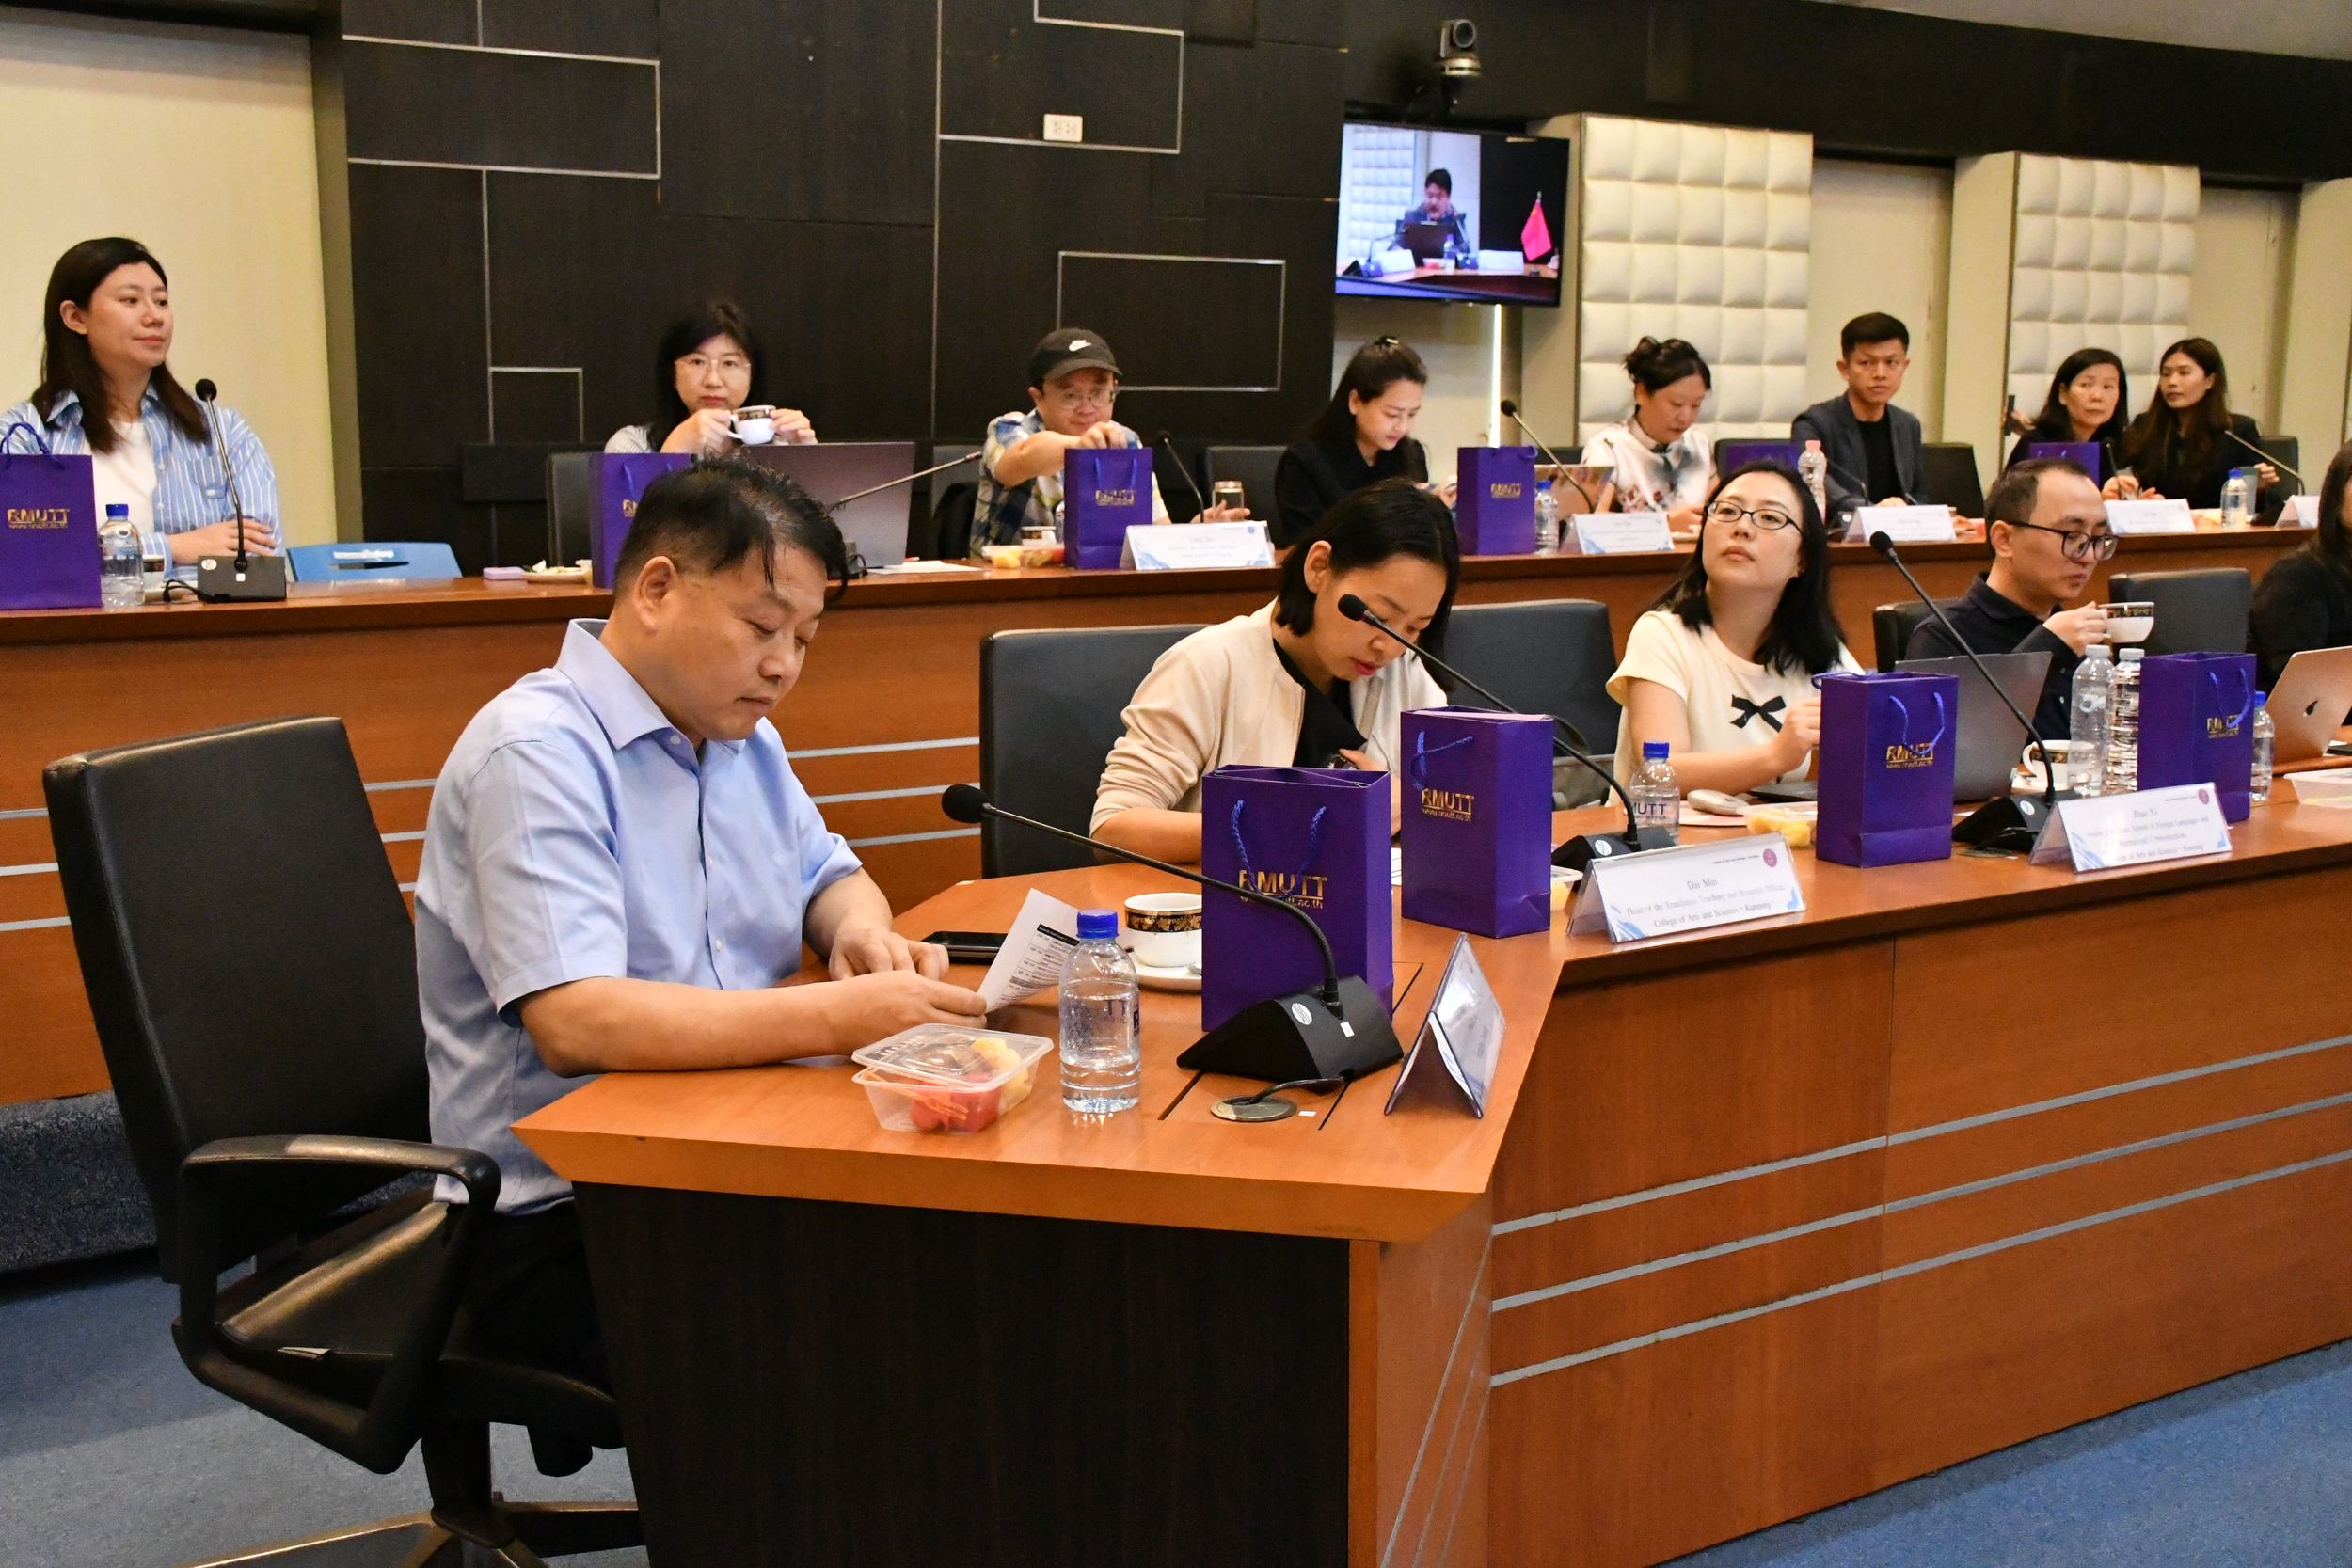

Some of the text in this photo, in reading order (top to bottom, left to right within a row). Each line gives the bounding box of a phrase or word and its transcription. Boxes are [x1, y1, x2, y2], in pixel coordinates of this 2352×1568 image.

[8, 509, 70, 522] RMUTT
[1422, 788, 1474, 812] RMUTT
[1702, 878, 1718, 889] Min
